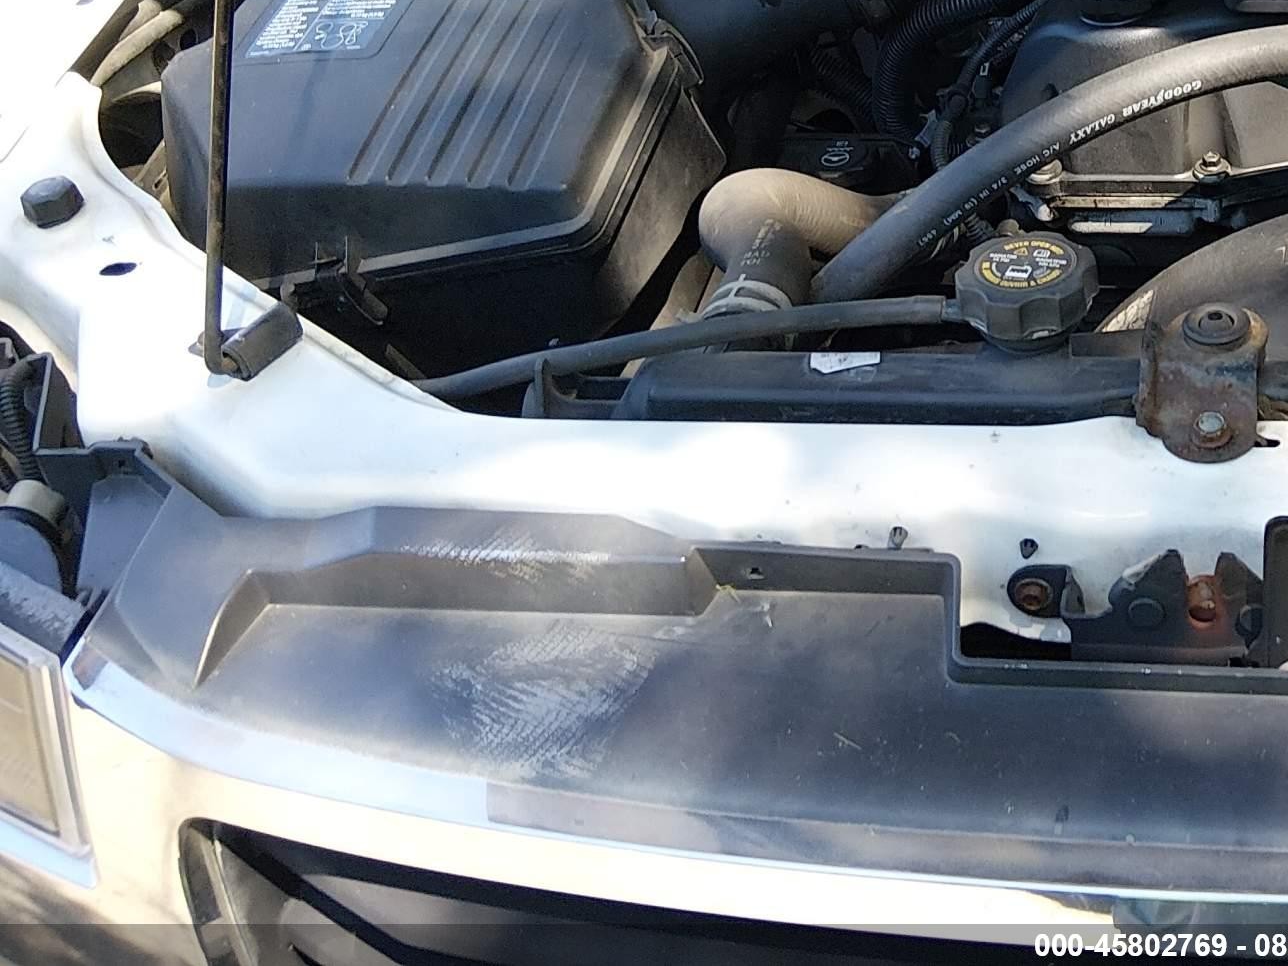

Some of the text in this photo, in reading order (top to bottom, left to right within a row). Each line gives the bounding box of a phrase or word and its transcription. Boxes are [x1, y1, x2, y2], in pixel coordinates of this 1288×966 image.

[1068, 113, 1116, 145] GALAXY
[1042, 141, 1060, 158] A/C
[1013, 154, 1041, 176] HOSE
